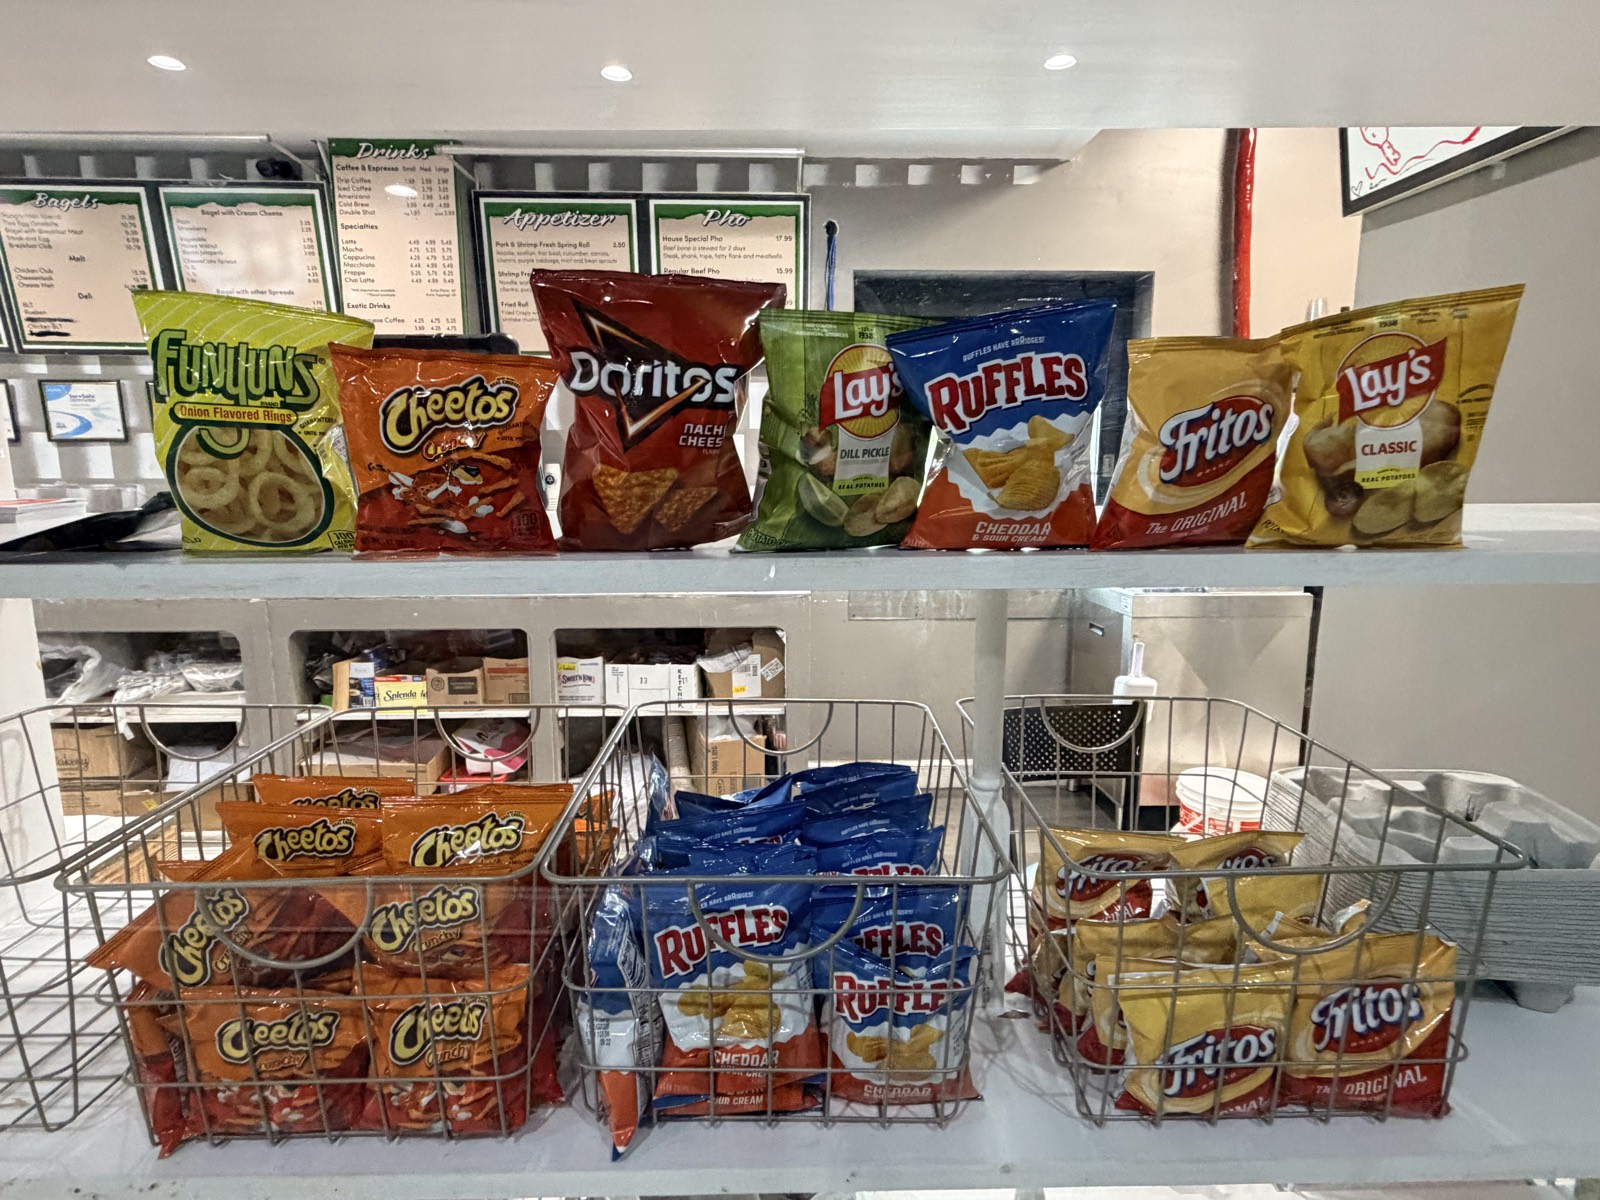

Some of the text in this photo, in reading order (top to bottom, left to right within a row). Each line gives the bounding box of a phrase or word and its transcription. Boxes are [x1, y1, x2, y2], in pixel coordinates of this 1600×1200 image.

[356, 142, 430, 160] Drinks
[368, 165, 399, 173] Espresso
[32, 192, 99, 212] Bagels
[340, 223, 378, 231] Specialties
[503, 208, 616, 231] Appetizer
[702, 209, 751, 227] Pho
[516, 241, 538, 249] Shrimp
[557, 241, 577, 249] Spring
[78, 292, 92, 300] Deli
[963, 346, 991, 362] RUFFLES
[993, 340, 1009, 351] HAVE
[152, 328, 320, 412] FUNYUNS
[569, 350, 738, 403] Doritos
[1344, 348, 1432, 413] Lay's
[834, 362, 904, 421] Lay's
[926, 353, 1087, 432] RUFFLES
[180, 405, 293, 424] Onion Flavored Rings
[382, 378, 516, 450] Cheetos
[684, 423, 726, 436] NACH
[679, 435, 723, 448] CHEES
[1159, 402, 1274, 483] Fritos
[1361, 440, 1418, 456] CLASSIC
[840, 446, 890, 460] DILL PICKLE
[855, 481, 886, 489] POTATOES
[1381, 473, 1416, 481] POTATOES
[1146, 491, 1247, 534] The ORIGINAL
[972, 533, 979, 541] &
[976, 521, 1051, 535] CHEDDAR
[384, 689, 417, 702] Splenda
[255, 818, 355, 862] Cheetos
[410, 812, 525, 867] Cheetos
[709, 898, 723, 906] HAVE
[369, 885, 481, 954] Cheetos
[654, 905, 789, 979] RUFFLES
[216, 1010, 339, 1063] Ceetos
[714, 1050, 780, 1067] CHEDDAR
[1155, 1028, 1276, 1097] Fritos
[733, 1094, 764, 1105] CREAM
